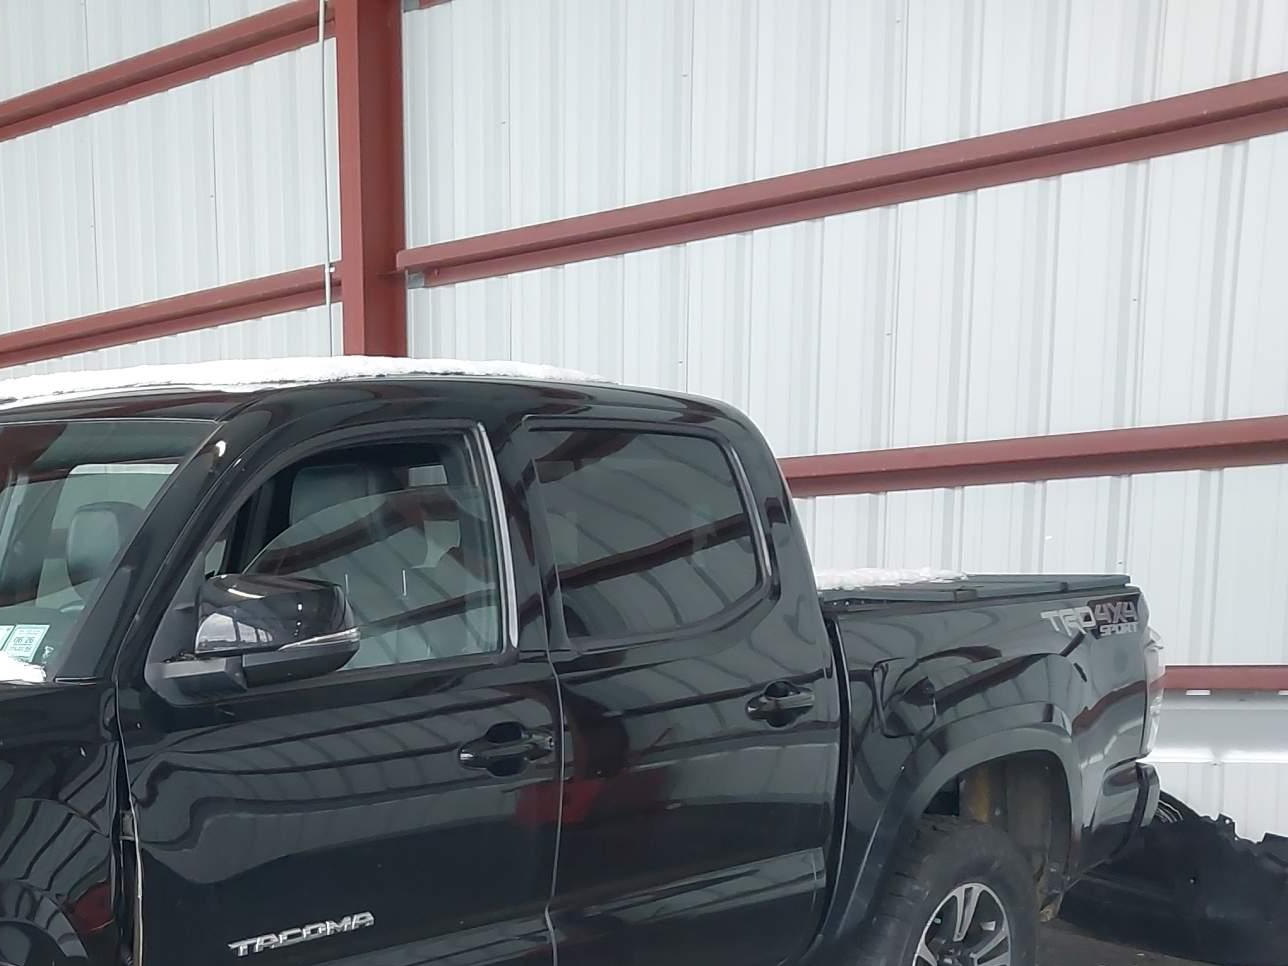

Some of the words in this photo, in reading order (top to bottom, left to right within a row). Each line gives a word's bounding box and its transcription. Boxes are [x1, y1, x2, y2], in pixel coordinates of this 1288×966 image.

[1040, 606, 1097, 637] TRD
[1099, 622, 1138, 636] SPORT
[227, 911, 375, 957] TACOMA
